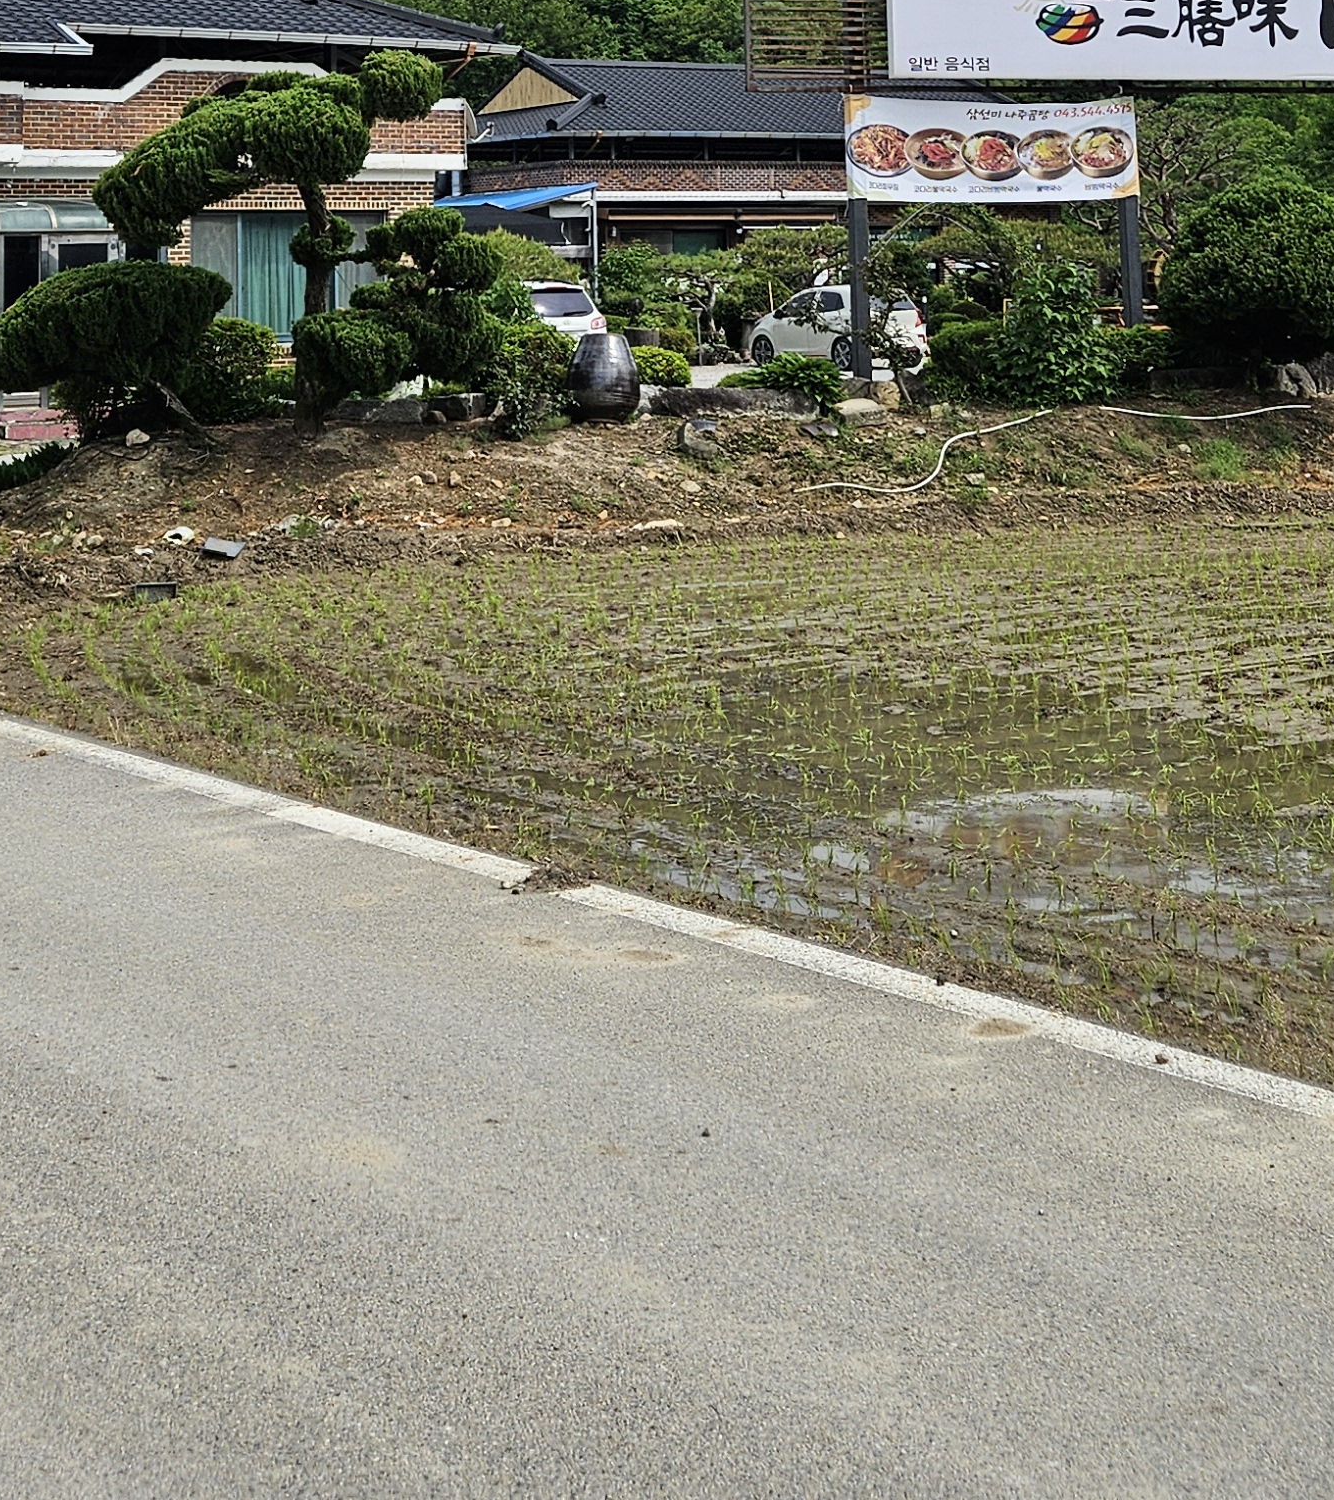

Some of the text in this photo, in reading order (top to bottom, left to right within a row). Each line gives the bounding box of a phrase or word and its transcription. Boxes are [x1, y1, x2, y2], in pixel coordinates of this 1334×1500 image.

[908, 56, 991, 72] 일반 음식점
[1053, 102, 1132, 118] 043.544.4575
